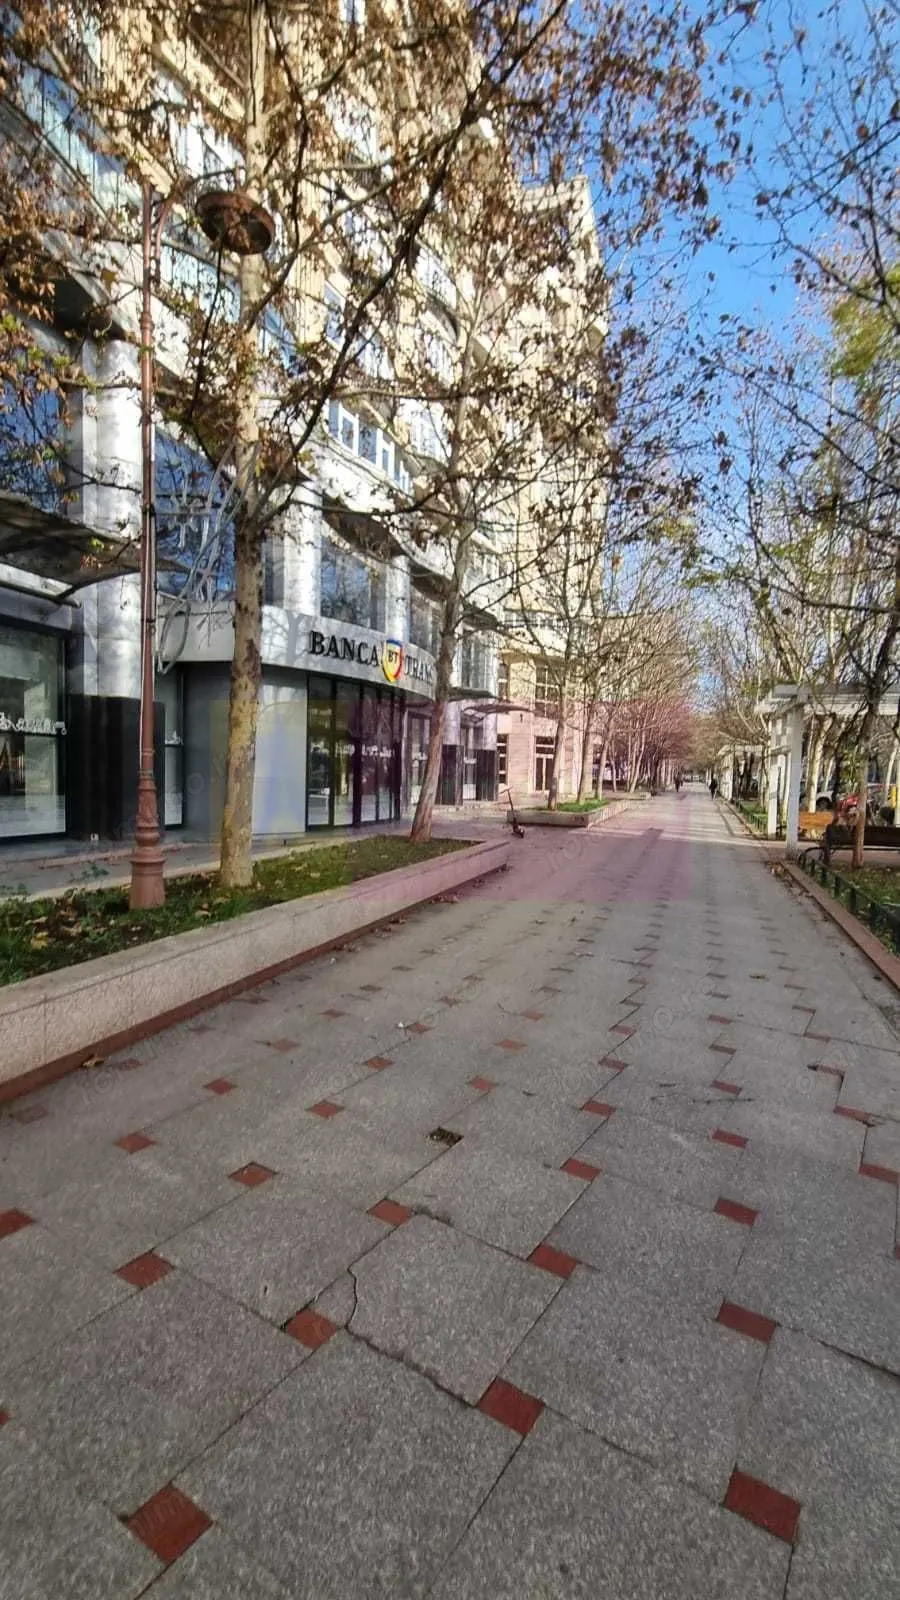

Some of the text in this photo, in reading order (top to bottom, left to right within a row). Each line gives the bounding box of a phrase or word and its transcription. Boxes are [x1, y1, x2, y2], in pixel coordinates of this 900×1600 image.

[309, 630, 434, 683] BANCA BT TRANS
